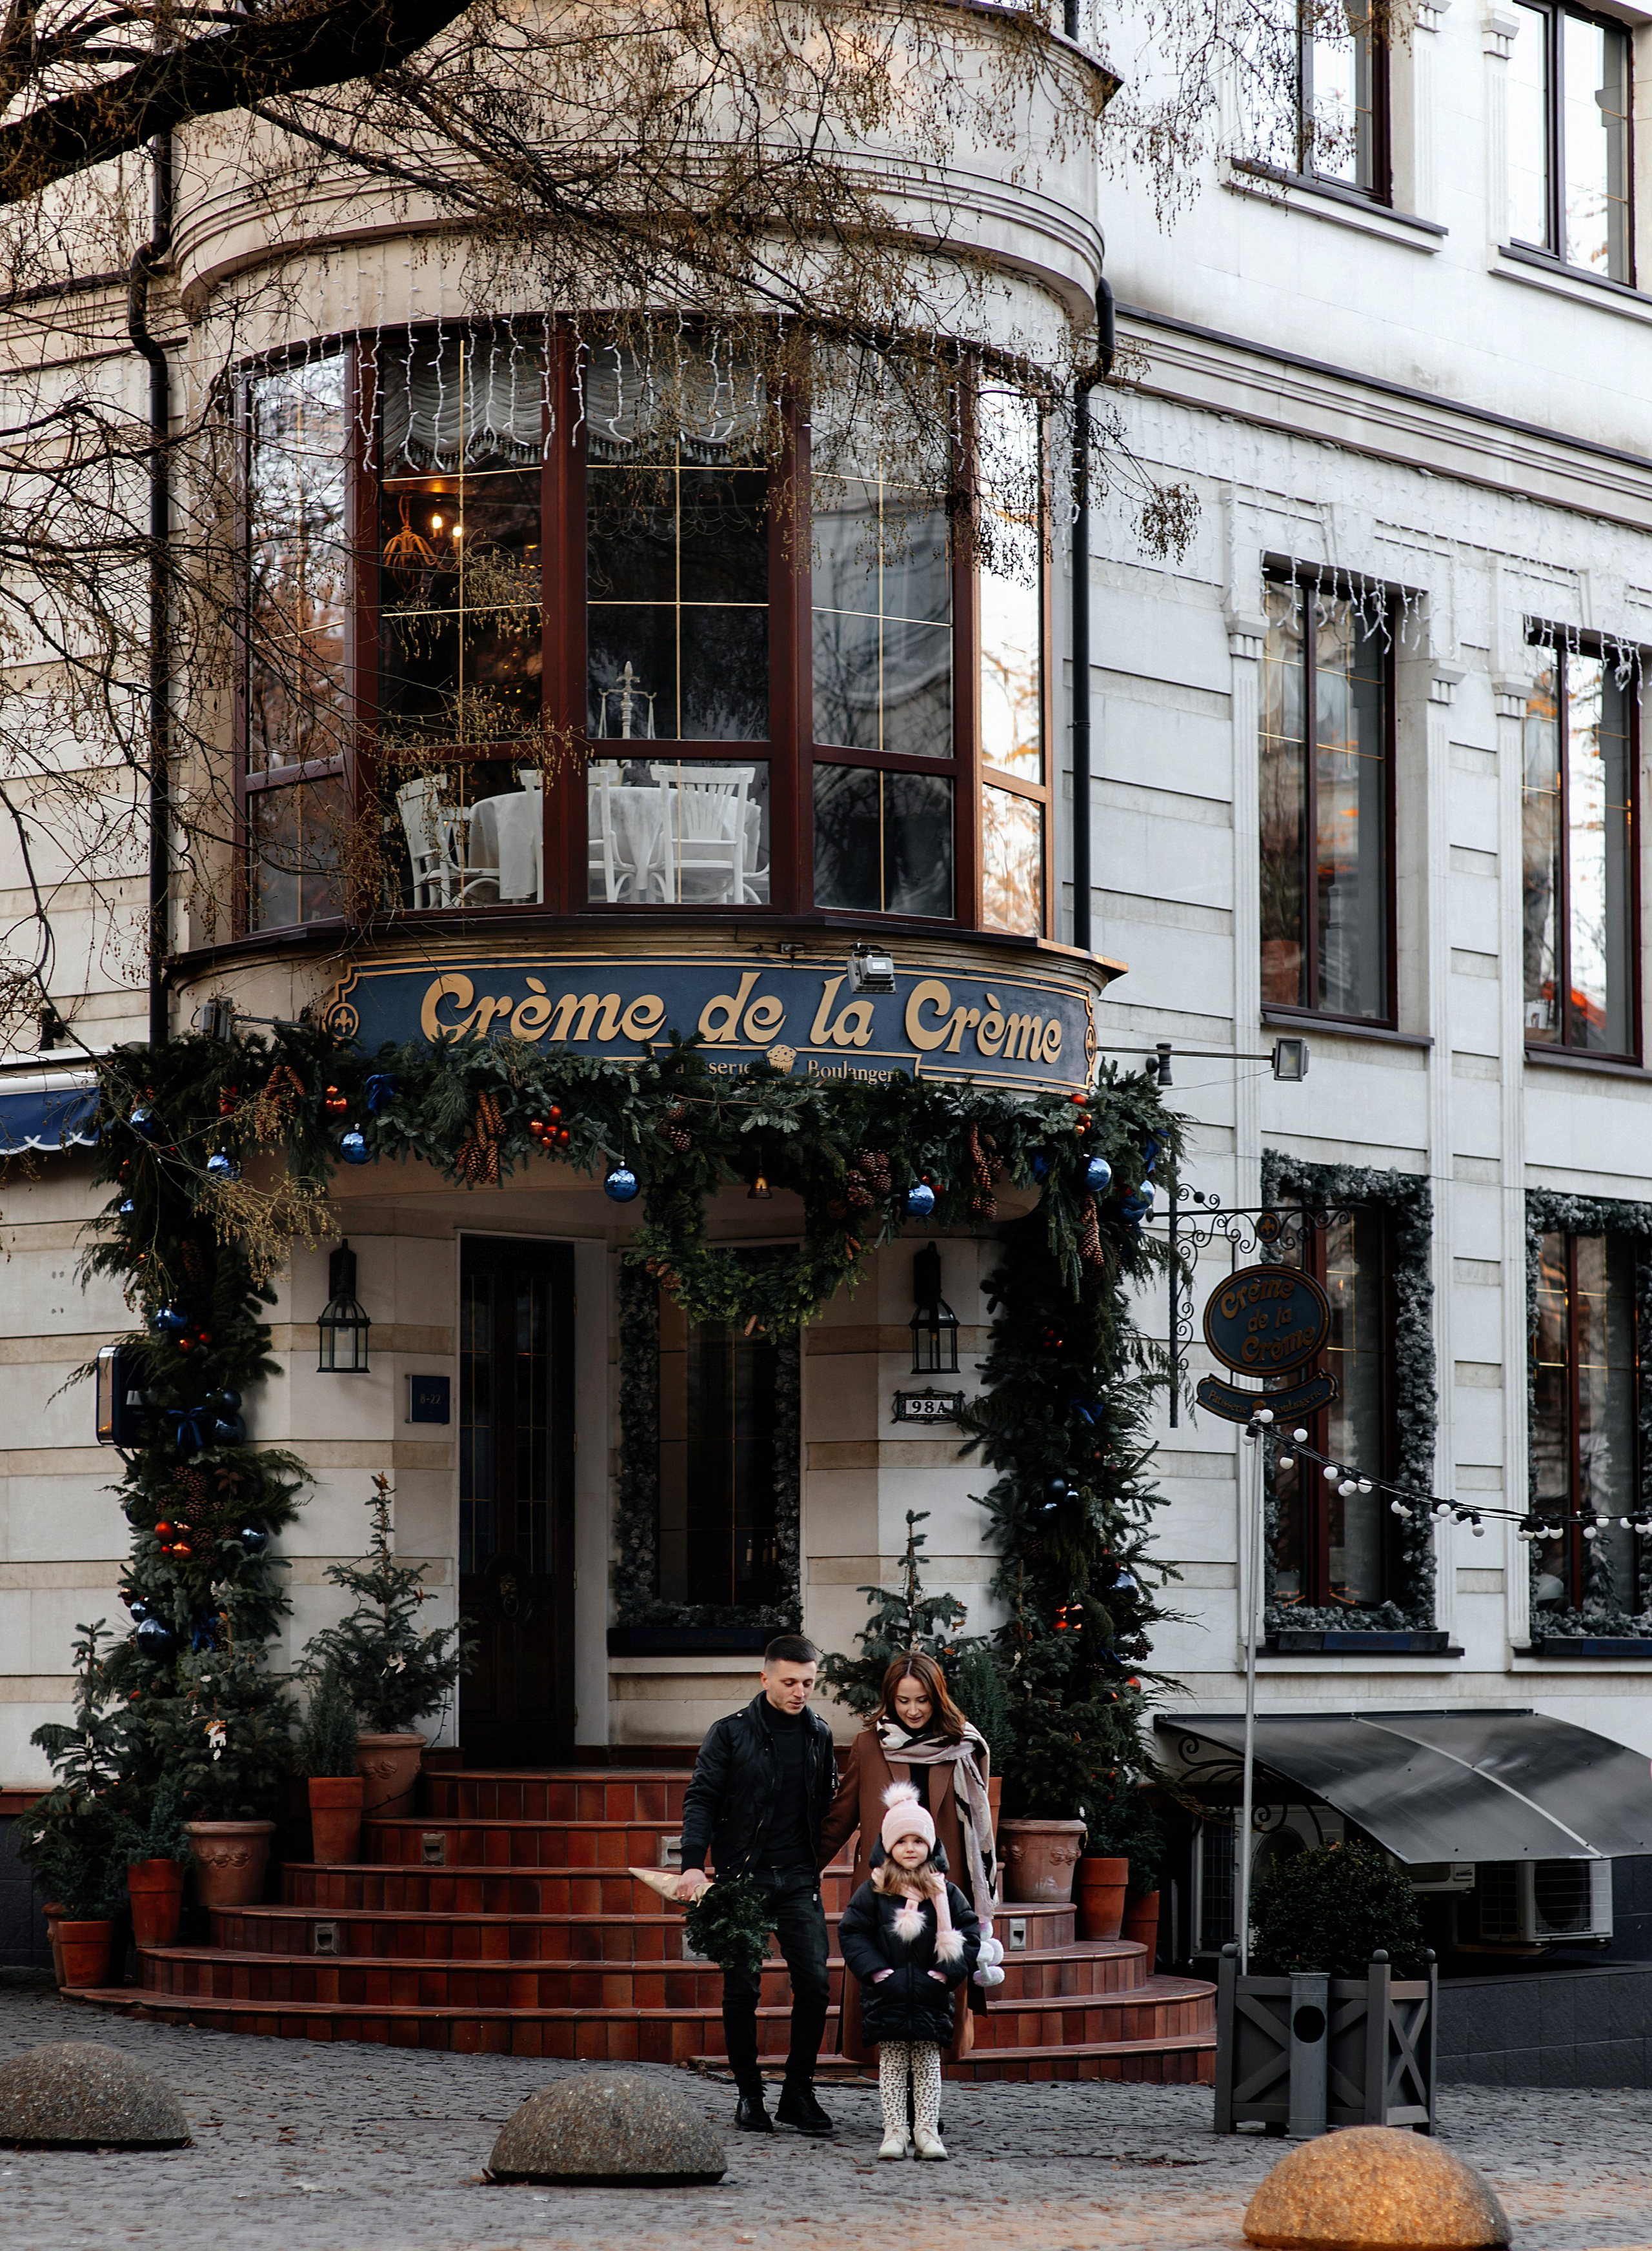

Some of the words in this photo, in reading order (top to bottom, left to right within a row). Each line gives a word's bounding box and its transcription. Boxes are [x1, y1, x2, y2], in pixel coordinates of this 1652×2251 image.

[420, 973, 667, 1044] Crème
[698, 971, 787, 1043] de
[809, 973, 875, 1047] la
[905, 979, 1063, 1064] Crème
[808, 1060, 900, 1085] Boulanger
[1220, 1277, 1295, 1320] Crème
[1248, 1307, 1269, 1333] de
[1275, 1306, 1293, 1329] la
[1241, 1326, 1316, 1363] Crème
[912, 1400, 948, 1414] 98A
